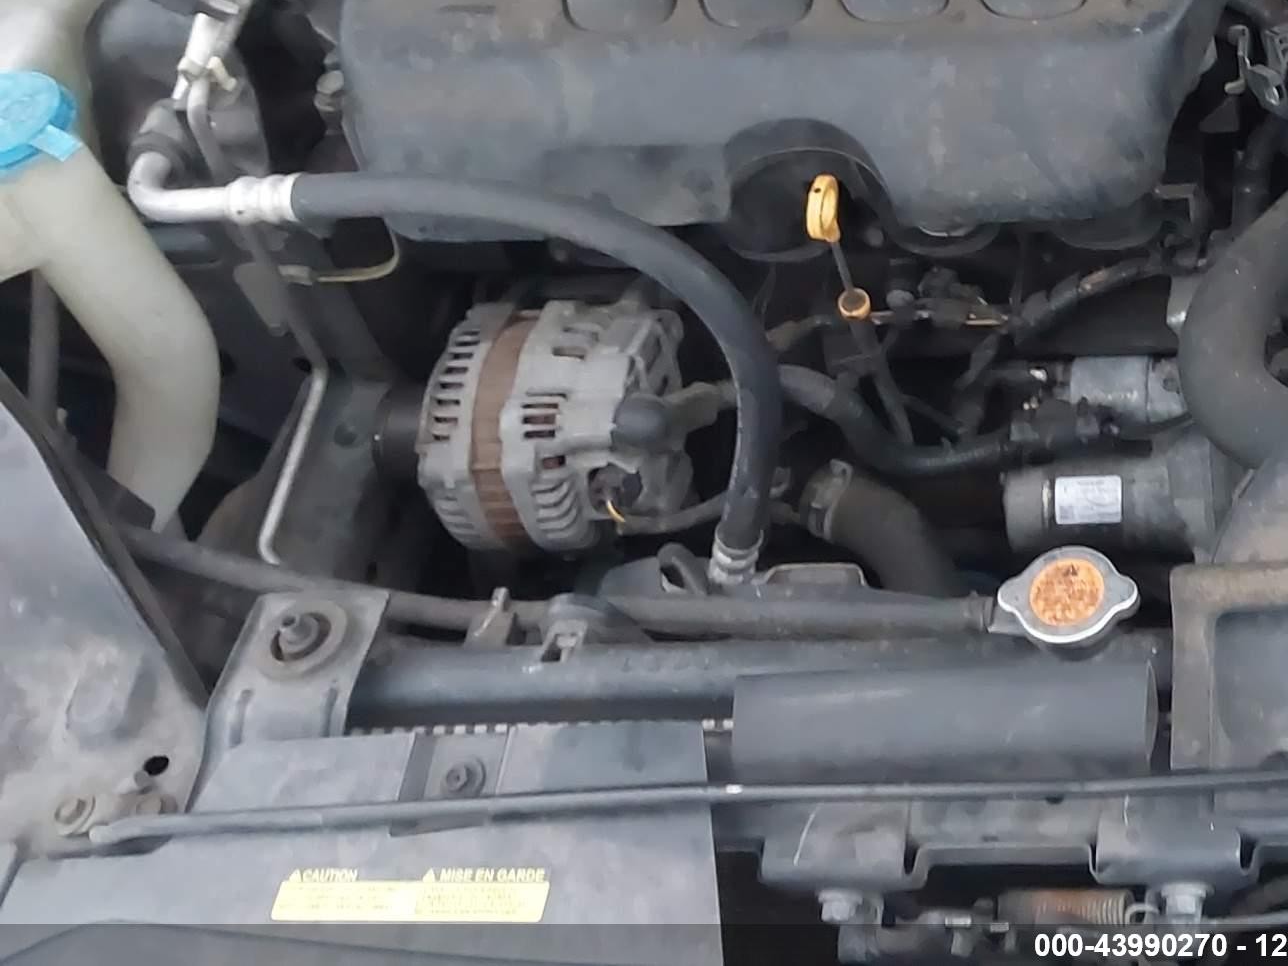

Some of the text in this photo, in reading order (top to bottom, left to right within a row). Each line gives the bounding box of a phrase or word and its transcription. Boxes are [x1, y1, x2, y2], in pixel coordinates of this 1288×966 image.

[301, 868, 358, 882] CAUTION
[439, 868, 546, 882] MISE EN GARDE
